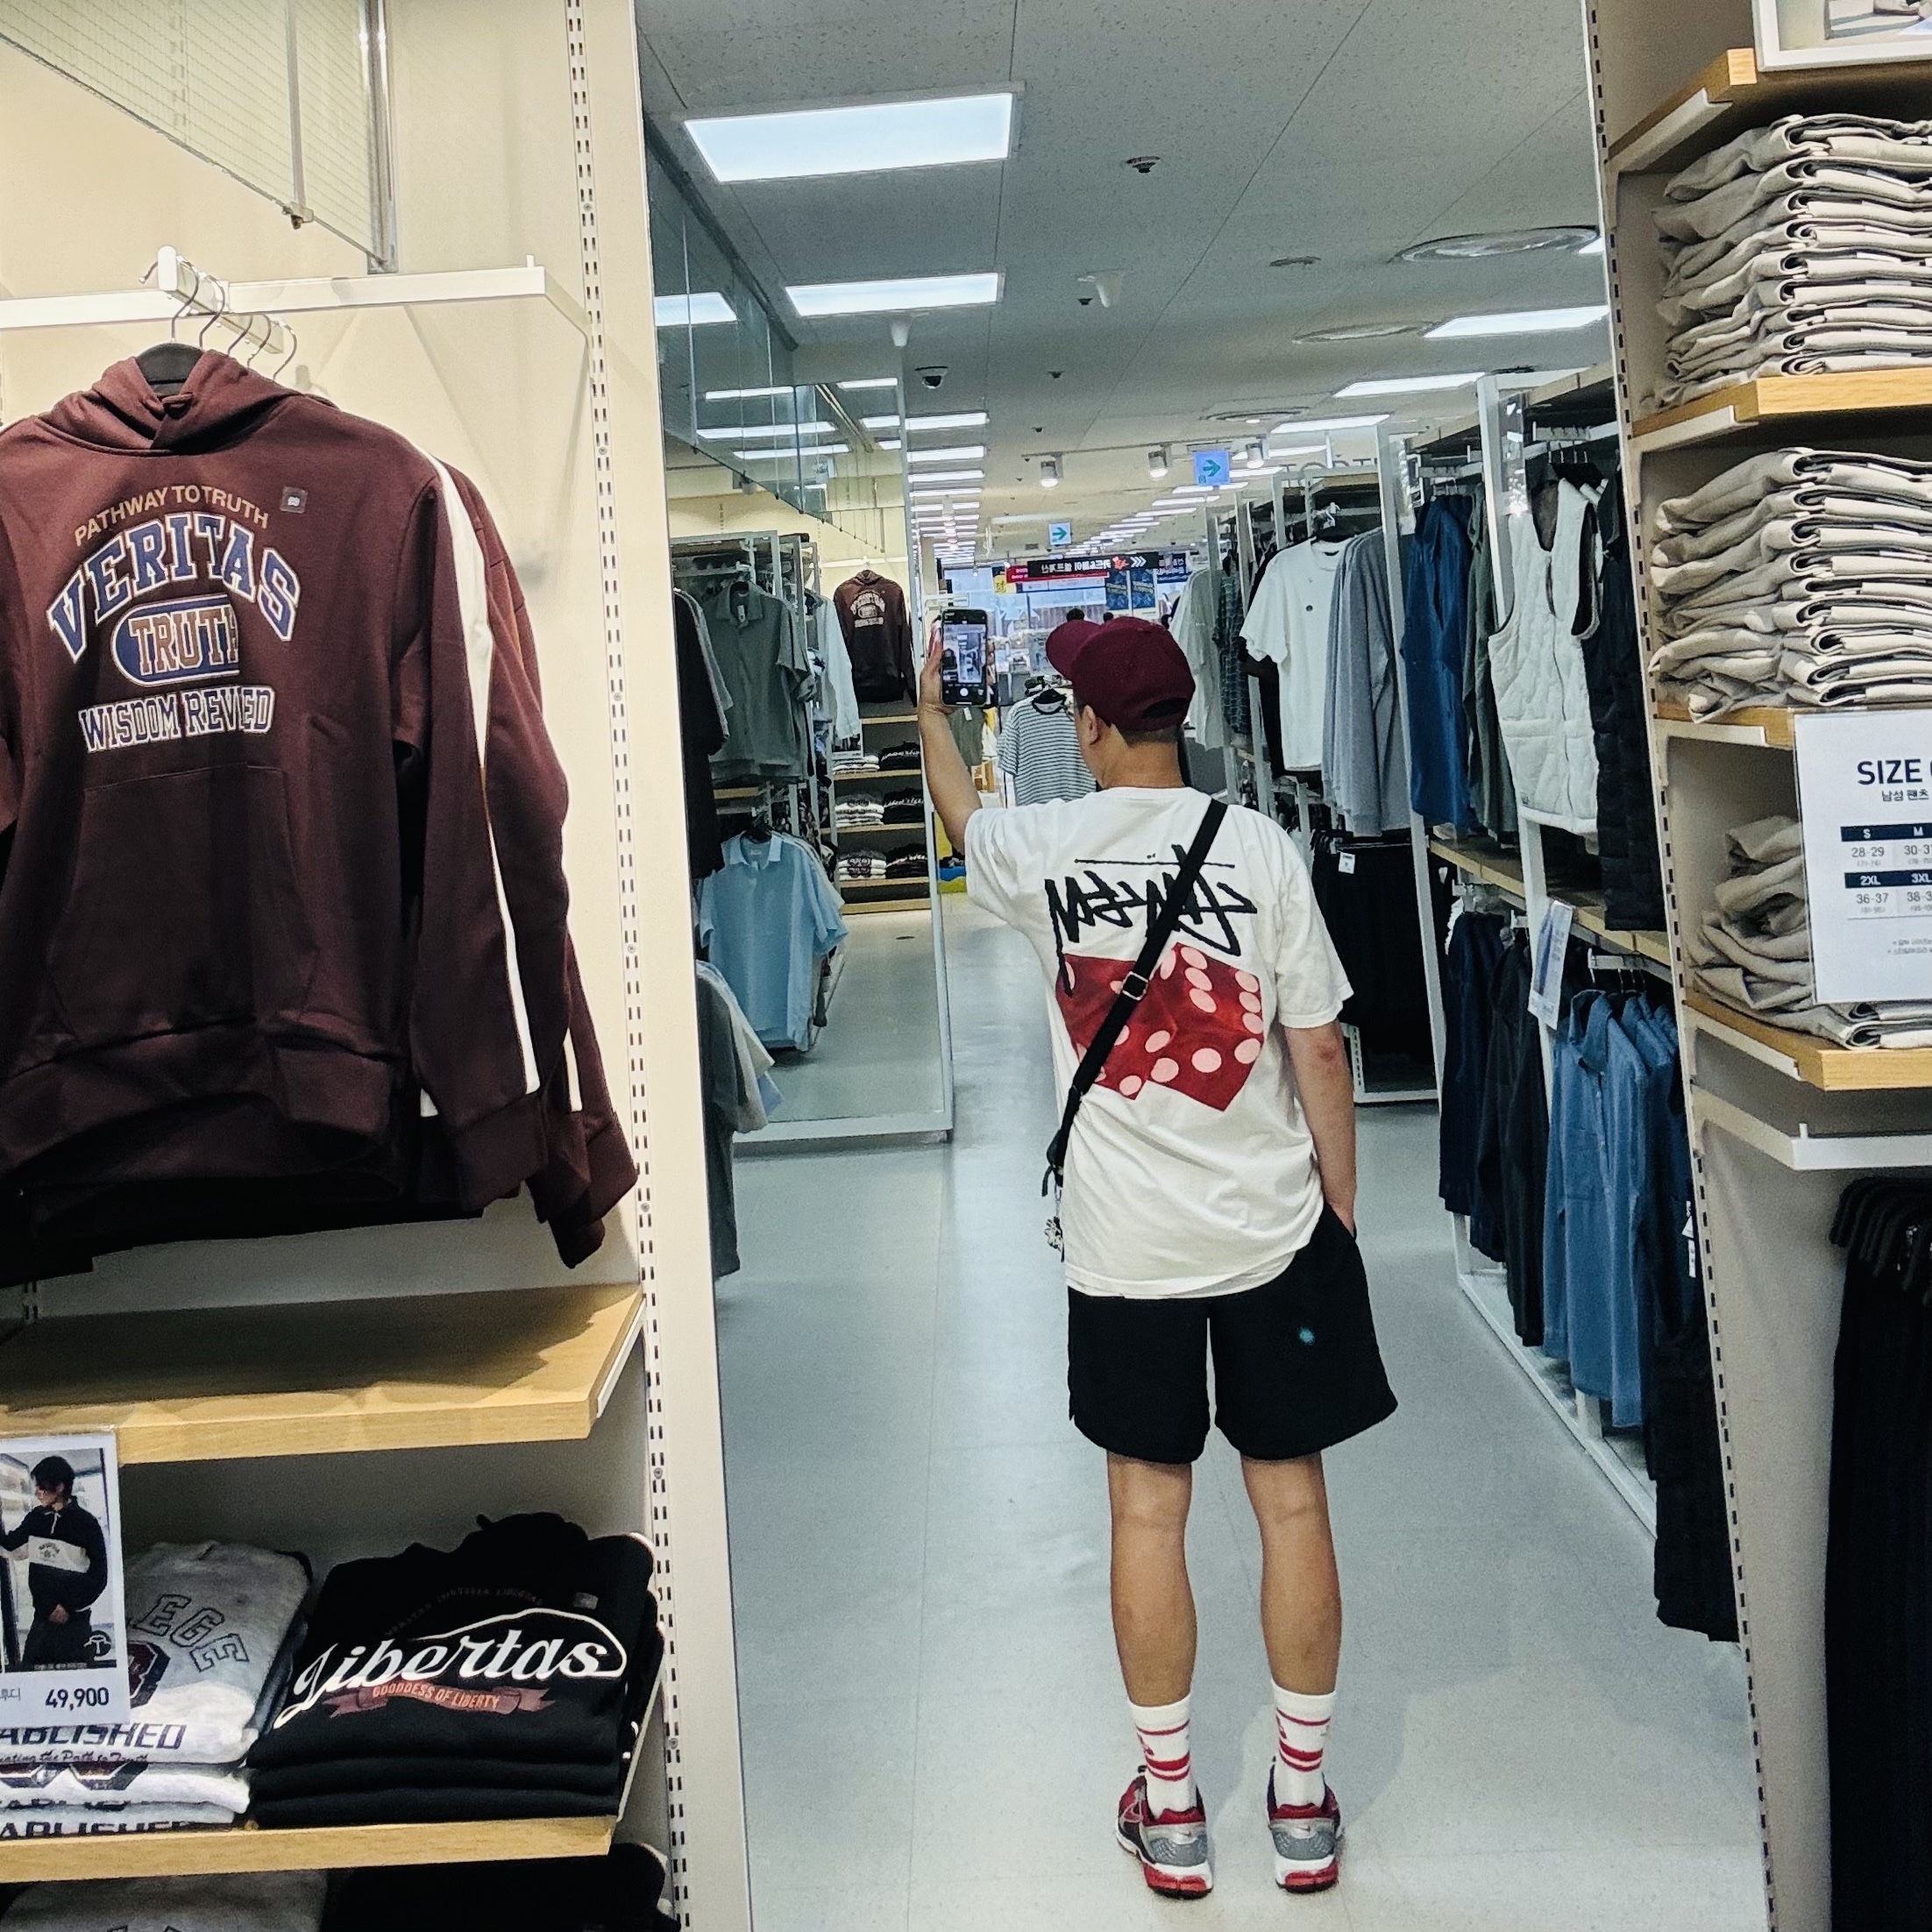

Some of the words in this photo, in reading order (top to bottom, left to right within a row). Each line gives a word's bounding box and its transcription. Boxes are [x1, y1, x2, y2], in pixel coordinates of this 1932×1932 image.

[74, 487, 168, 547] PATHWAY
[174, 485, 201, 503] TO
[202, 485, 269, 529] TRUTH
[46, 511, 301, 664] VERITAS
[79, 692, 181, 752] WISDOM
[1857, 758, 1923, 785] SIZE
[1881, 790, 1904, 802] 남성
[1907, 788, 1930, 801] 팬츠
[1863, 827, 1872, 839] S
[1913, 826, 1924, 836] M
[1850, 846, 1885, 858] 28-29
[1860, 875, 1881, 886] 2XL
[1911, 873, 1932, 884] 3XL
[1856, 892, 1889, 905] 36-37
[45, 1687, 110, 1711] 49,900
[435, 1689, 451, 1702] OF
[451, 1692, 500, 1708] LIBERTY
